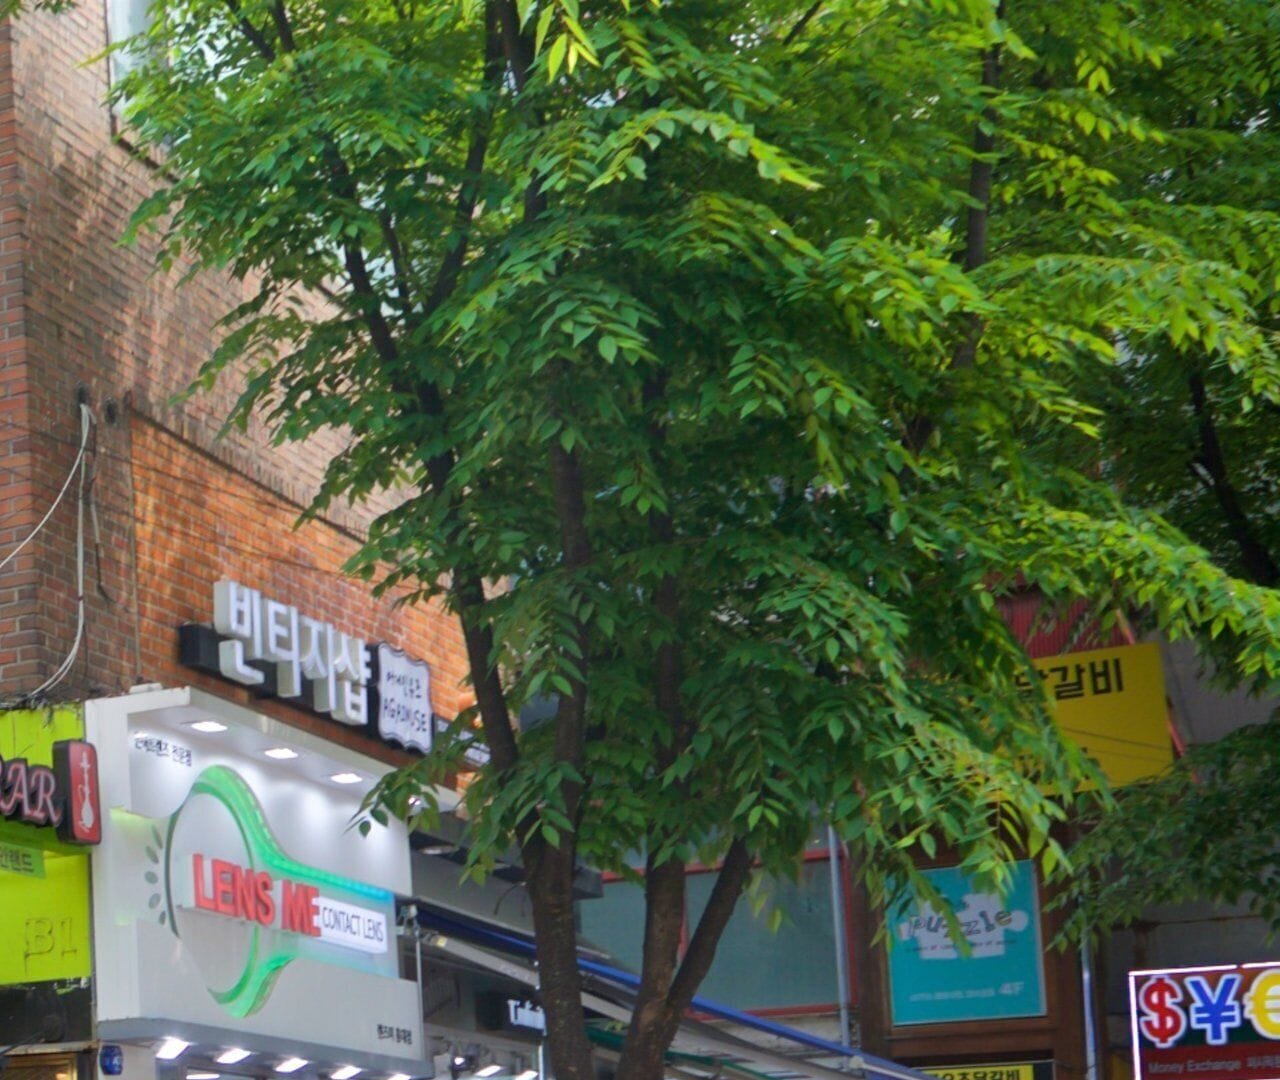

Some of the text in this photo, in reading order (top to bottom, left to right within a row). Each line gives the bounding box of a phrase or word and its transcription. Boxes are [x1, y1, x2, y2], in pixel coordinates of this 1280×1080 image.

[216, 579, 371, 725] 빈티지샵
[193, 852, 322, 937] LENS ME
[322, 907, 384, 942] CONTACT LENS
